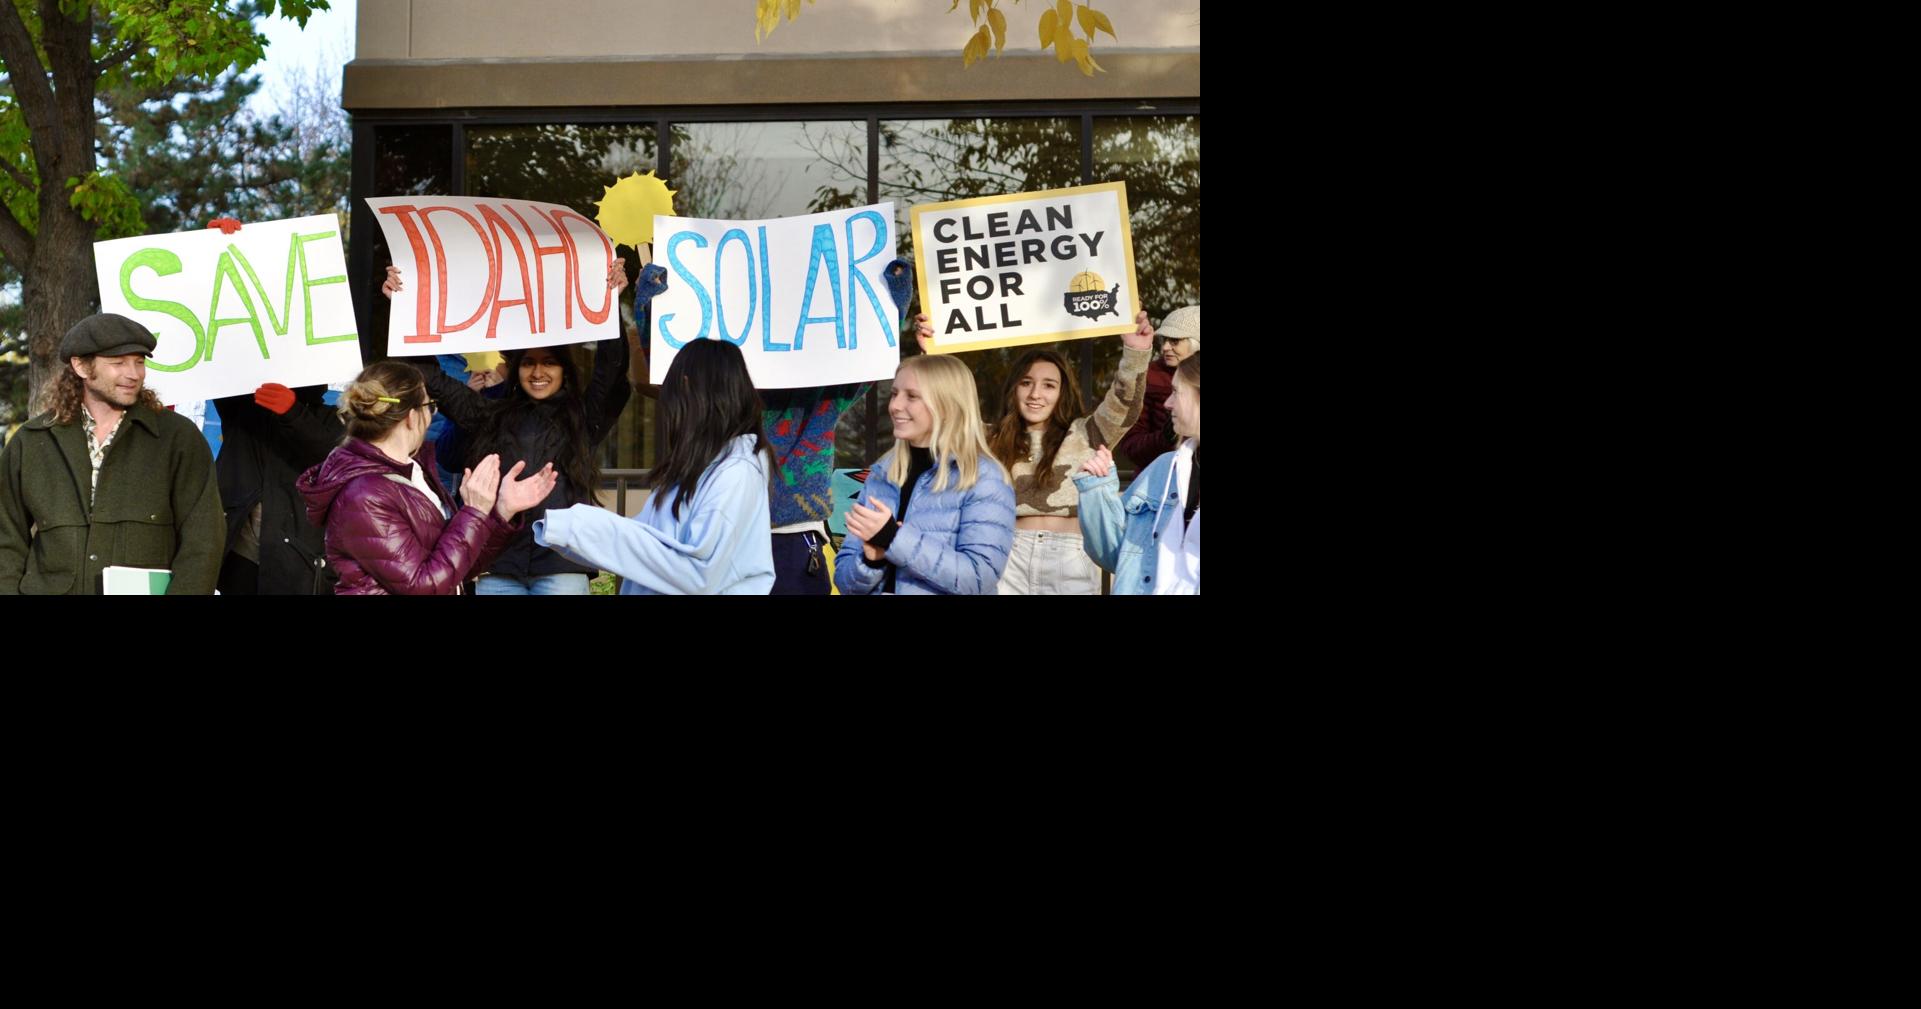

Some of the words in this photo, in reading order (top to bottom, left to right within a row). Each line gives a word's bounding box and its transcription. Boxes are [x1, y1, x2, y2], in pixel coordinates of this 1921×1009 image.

[933, 205, 1073, 243] CLEAN
[937, 231, 1104, 274] ENERGY
[378, 204, 613, 343] IDAHO
[659, 211, 896, 351] SOLAR
[940, 272, 1024, 304] FOR
[120, 231, 358, 372] SAVE
[1073, 299, 1110, 312] 100%
[1094, 293, 1108, 301] FOR
[945, 304, 1022, 334] ALL
